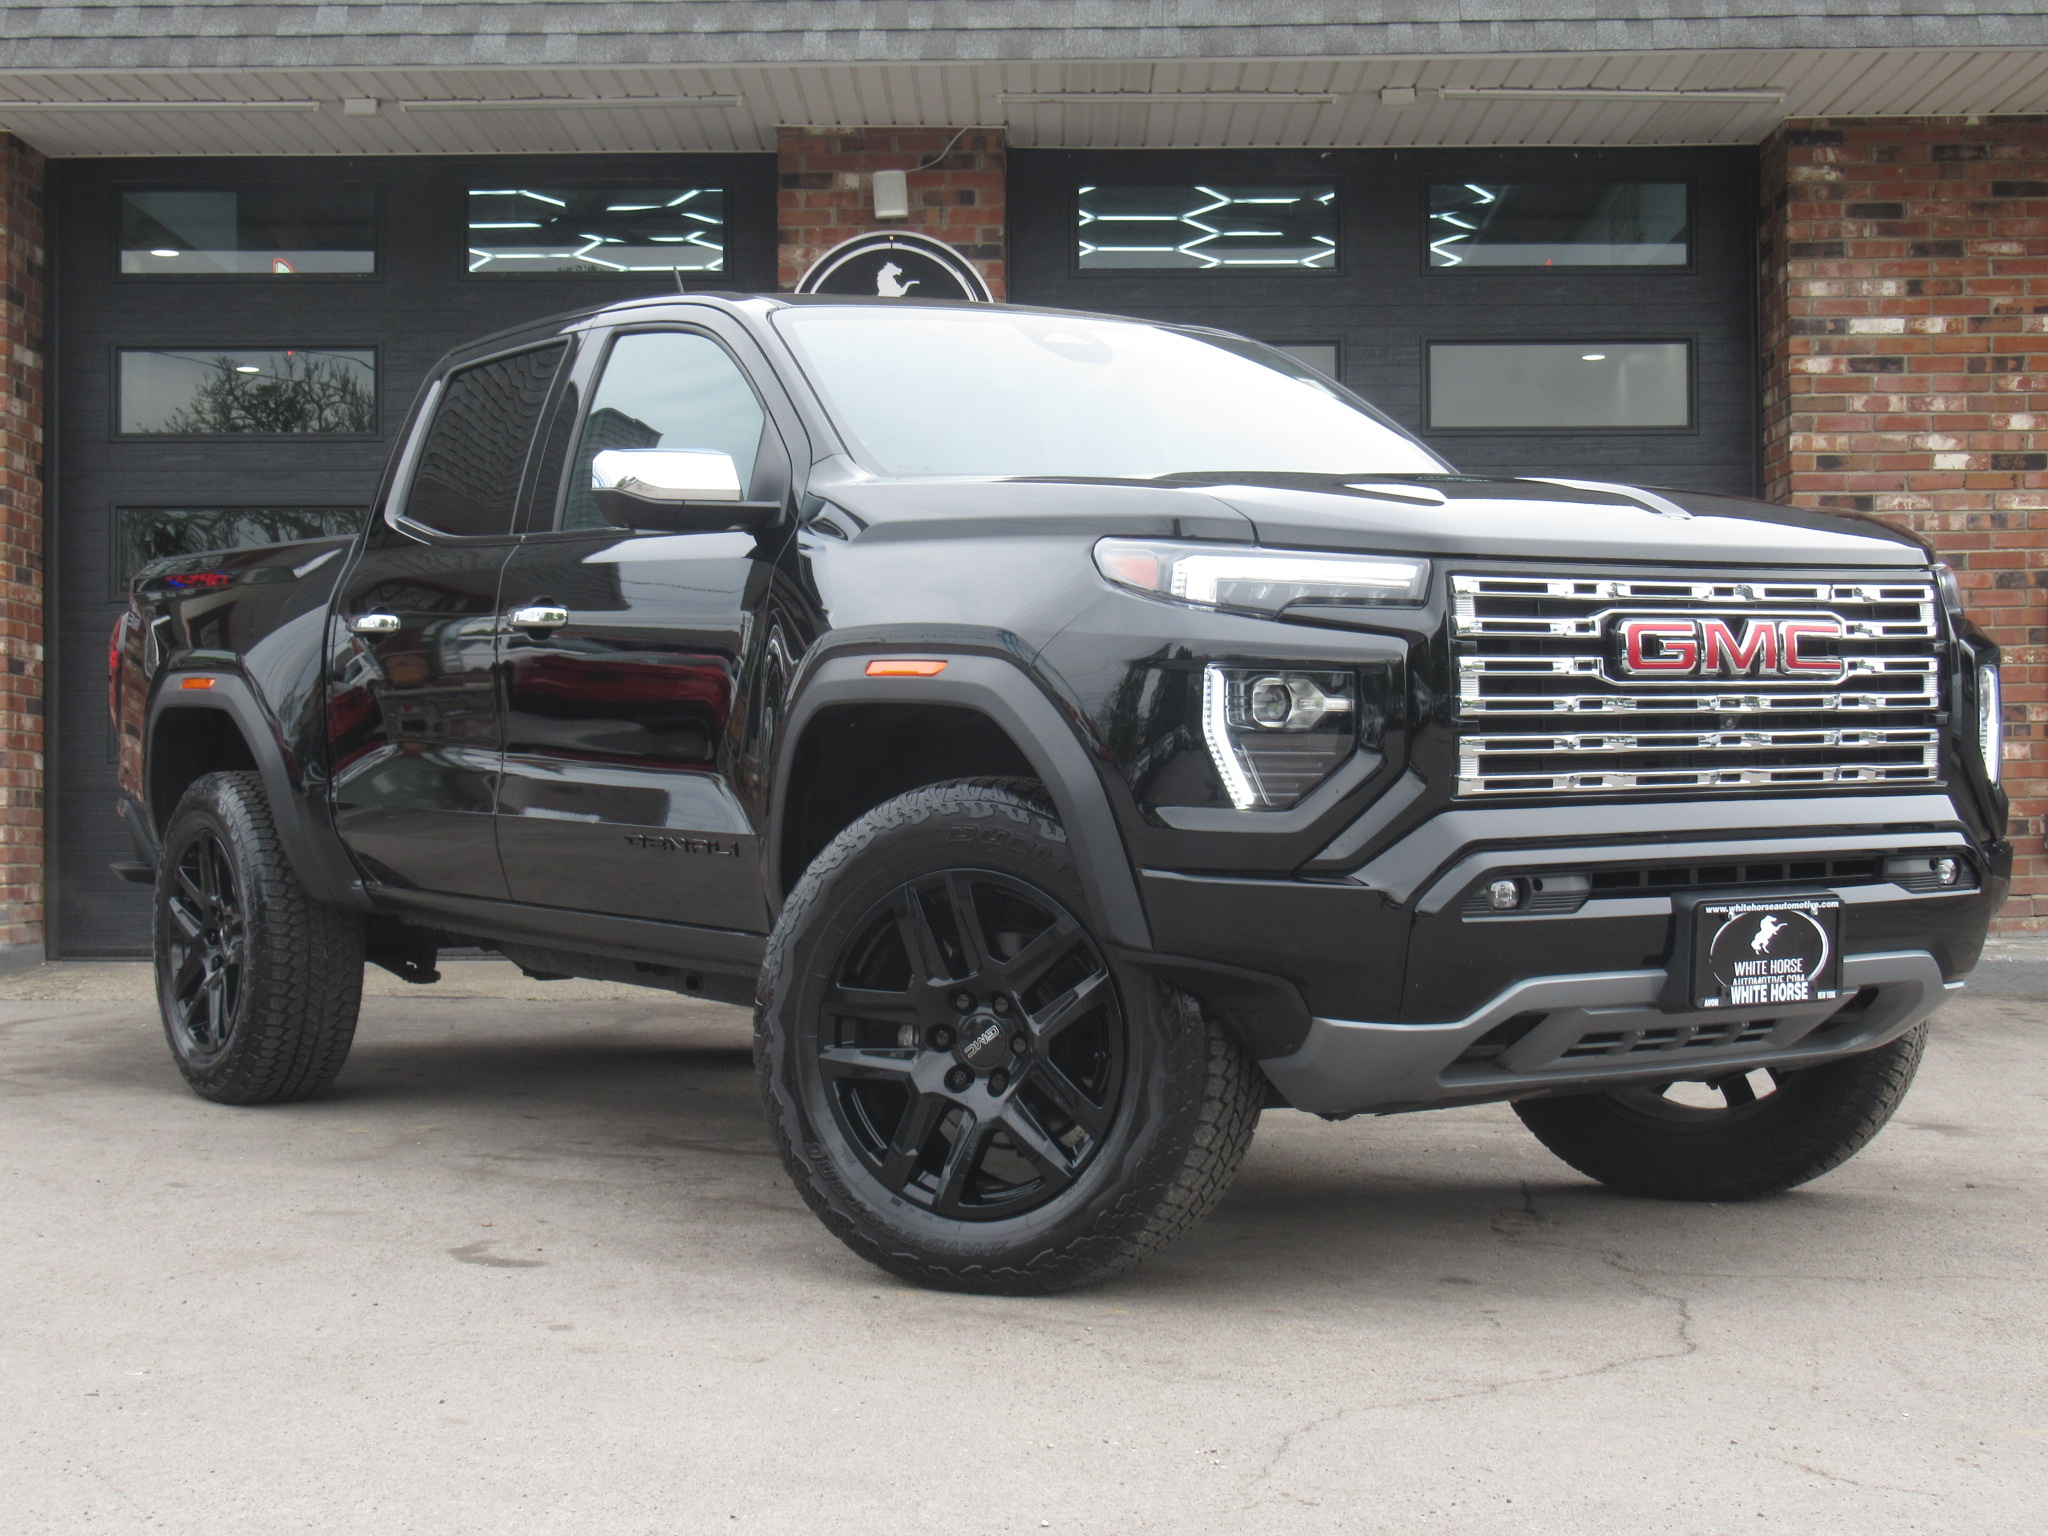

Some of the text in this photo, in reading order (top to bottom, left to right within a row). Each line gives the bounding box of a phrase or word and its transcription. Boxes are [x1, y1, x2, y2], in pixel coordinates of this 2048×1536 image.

[1619, 619, 1845, 675] GMC
[624, 834, 740, 858] DENALI
[1705, 901, 1839, 914] www.whitehorseautomotive.com
[1734, 958, 1804, 977] WHITE HORSE
[1733, 974, 1805, 986] AUTOMOTIVECOM
[1730, 982, 1809, 1005] WHITE HORSE
[963, 1025, 999, 1059] GMC
